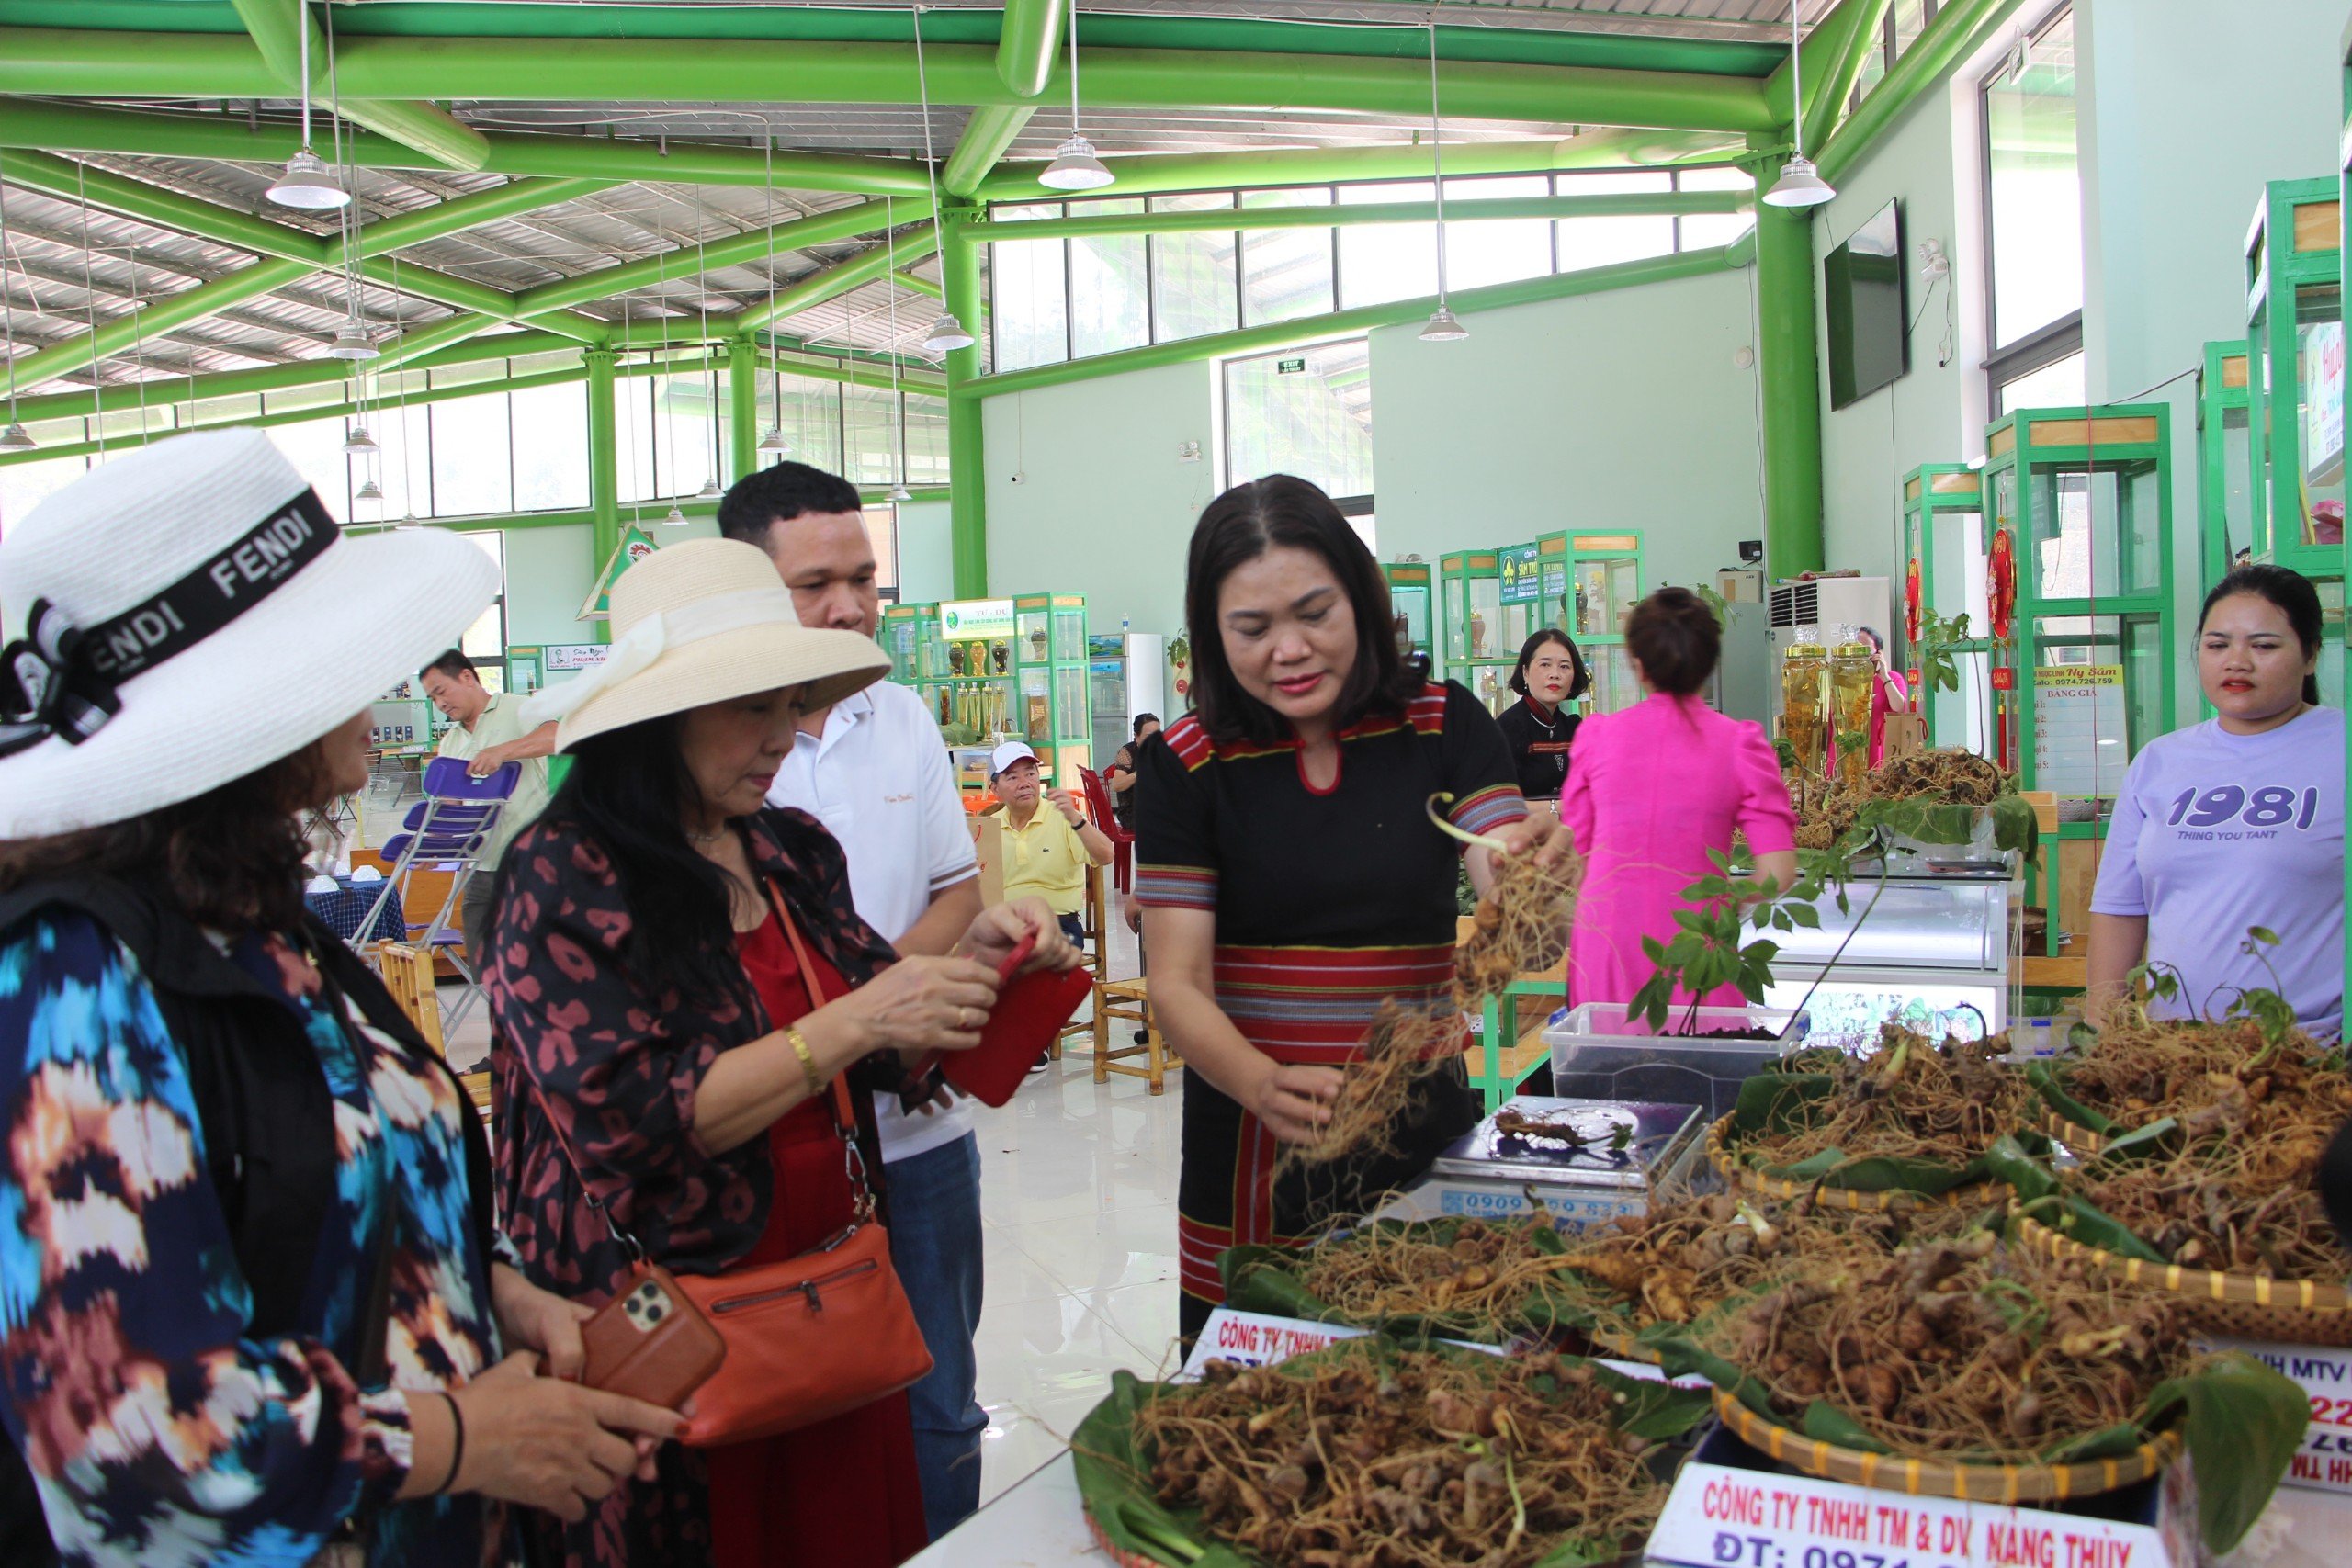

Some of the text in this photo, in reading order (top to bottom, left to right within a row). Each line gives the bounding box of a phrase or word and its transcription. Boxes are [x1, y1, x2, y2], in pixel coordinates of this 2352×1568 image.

[209, 508, 313, 598] FENDI
[94, 600, 184, 672] ENDI
[2066, 668, 2085, 679] Ny
[2088, 667, 2117, 677] Sâm
[2166, 784, 2318, 831] 1981
[2177, 830, 2278, 840] THING YOU TANT
[1466, 1194, 1521, 1210] 0909
[1218, 1316, 1258, 1352] CÔNG
[1262, 1326, 1281, 1354] TY
[2292, 1357, 2346, 1382] MTV
[1703, 1474, 1764, 1526] CÔNG
[1772, 1492, 1801, 1530] TY
[1806, 1496, 1869, 1542] TNHH
[1876, 1506, 1909, 1548] TM
[1915, 1513, 1932, 1551] &
[1940, 1516, 1973, 1557] DV
[1713, 1531, 1785, 1568] ĐT:
